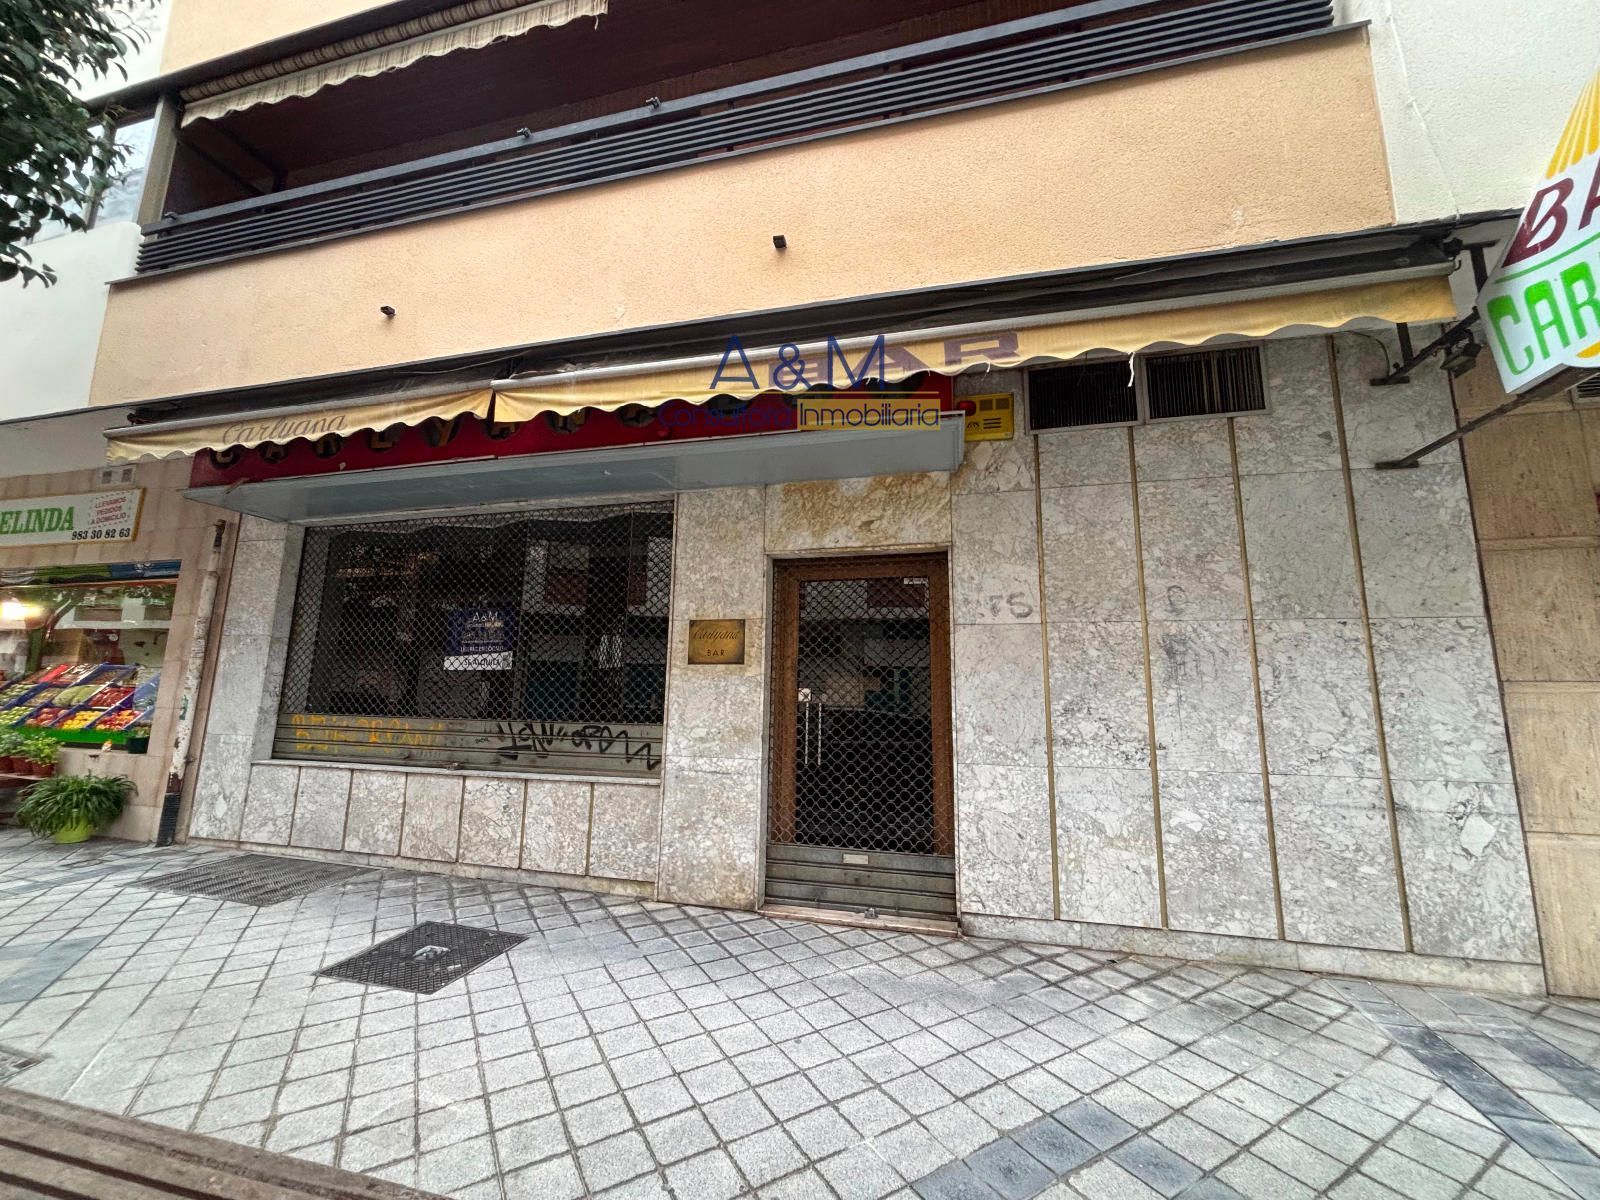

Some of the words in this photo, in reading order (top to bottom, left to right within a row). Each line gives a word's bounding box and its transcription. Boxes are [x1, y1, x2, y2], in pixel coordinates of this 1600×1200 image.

[71, 530, 89, 541] 983
[90, 529, 102, 540] 30
[104, 528, 116, 539] 82
[118, 527, 131, 538] 63
[706, 649, 725, 657] BAR
